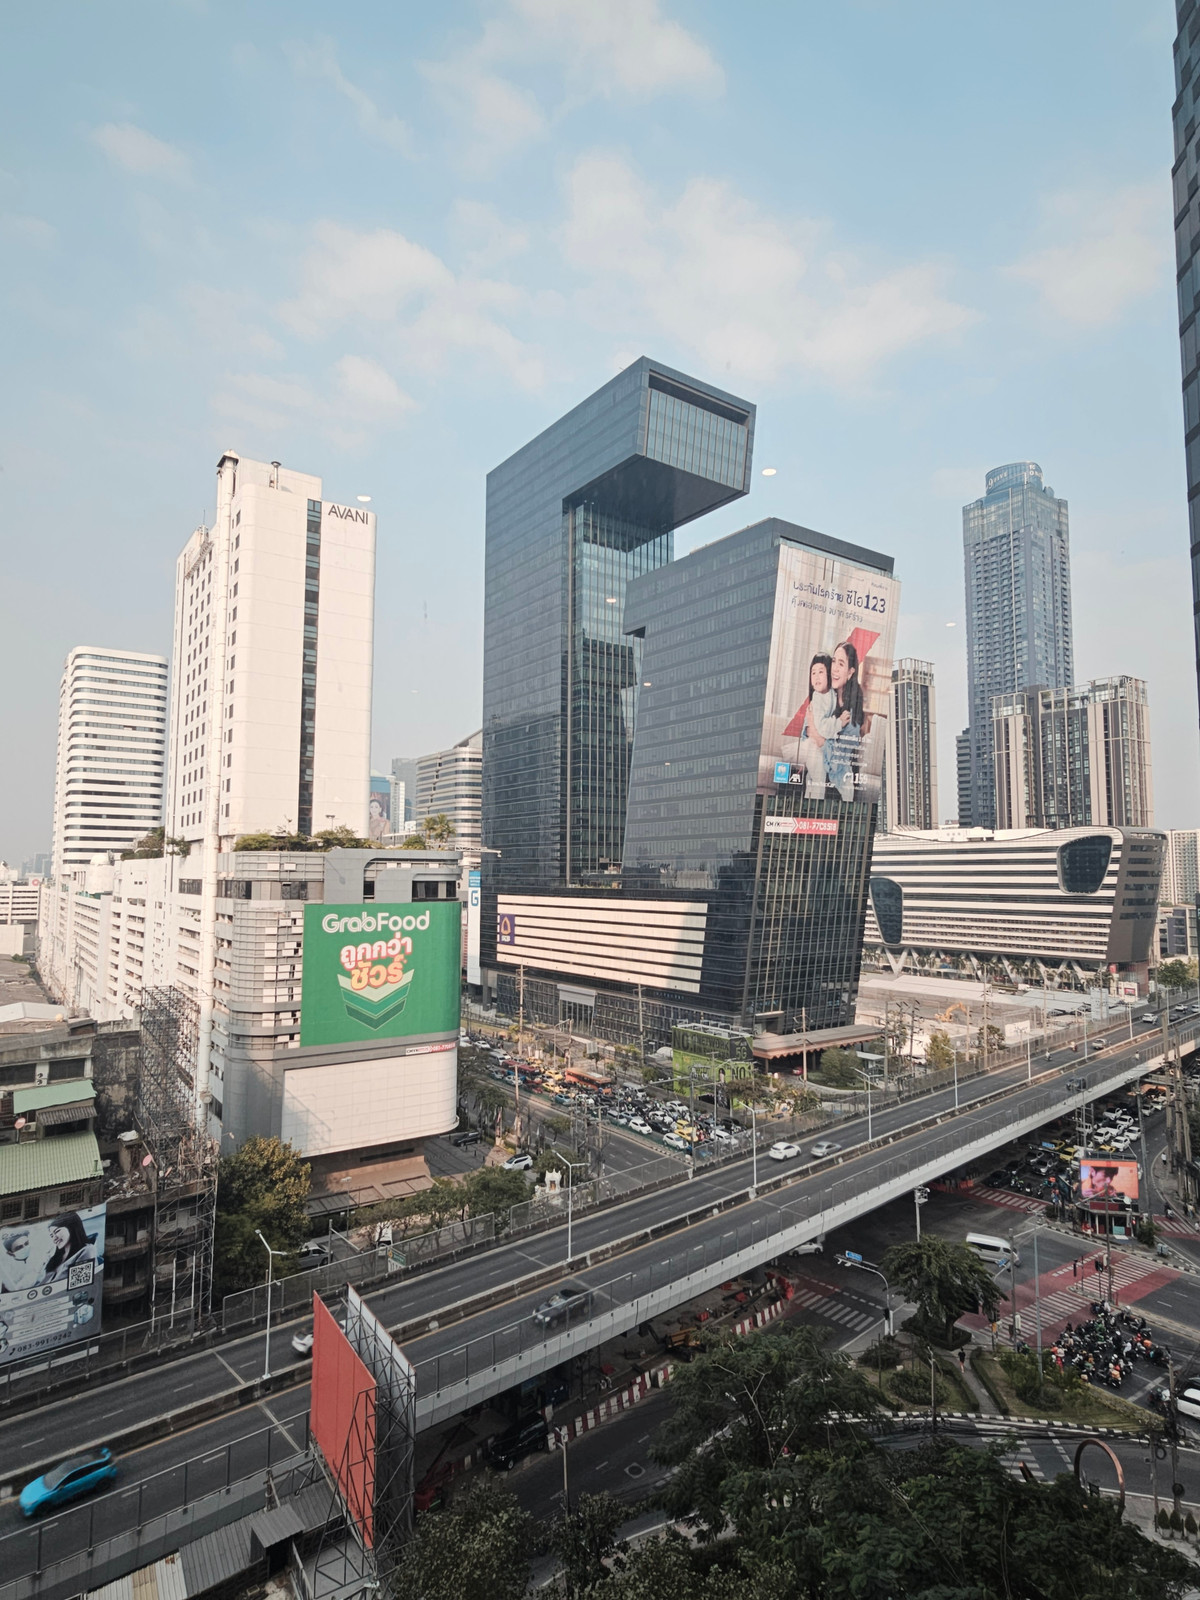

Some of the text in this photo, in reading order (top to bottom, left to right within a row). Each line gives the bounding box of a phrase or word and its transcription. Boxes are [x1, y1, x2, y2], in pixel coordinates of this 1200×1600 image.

[328, 504, 369, 525] AVANI
[471, 890, 479, 907] G
[322, 910, 430, 933] GrabFood
[340, 932, 413, 970] ถูกกว่า
[735, 1046, 748, 1060] 5G
